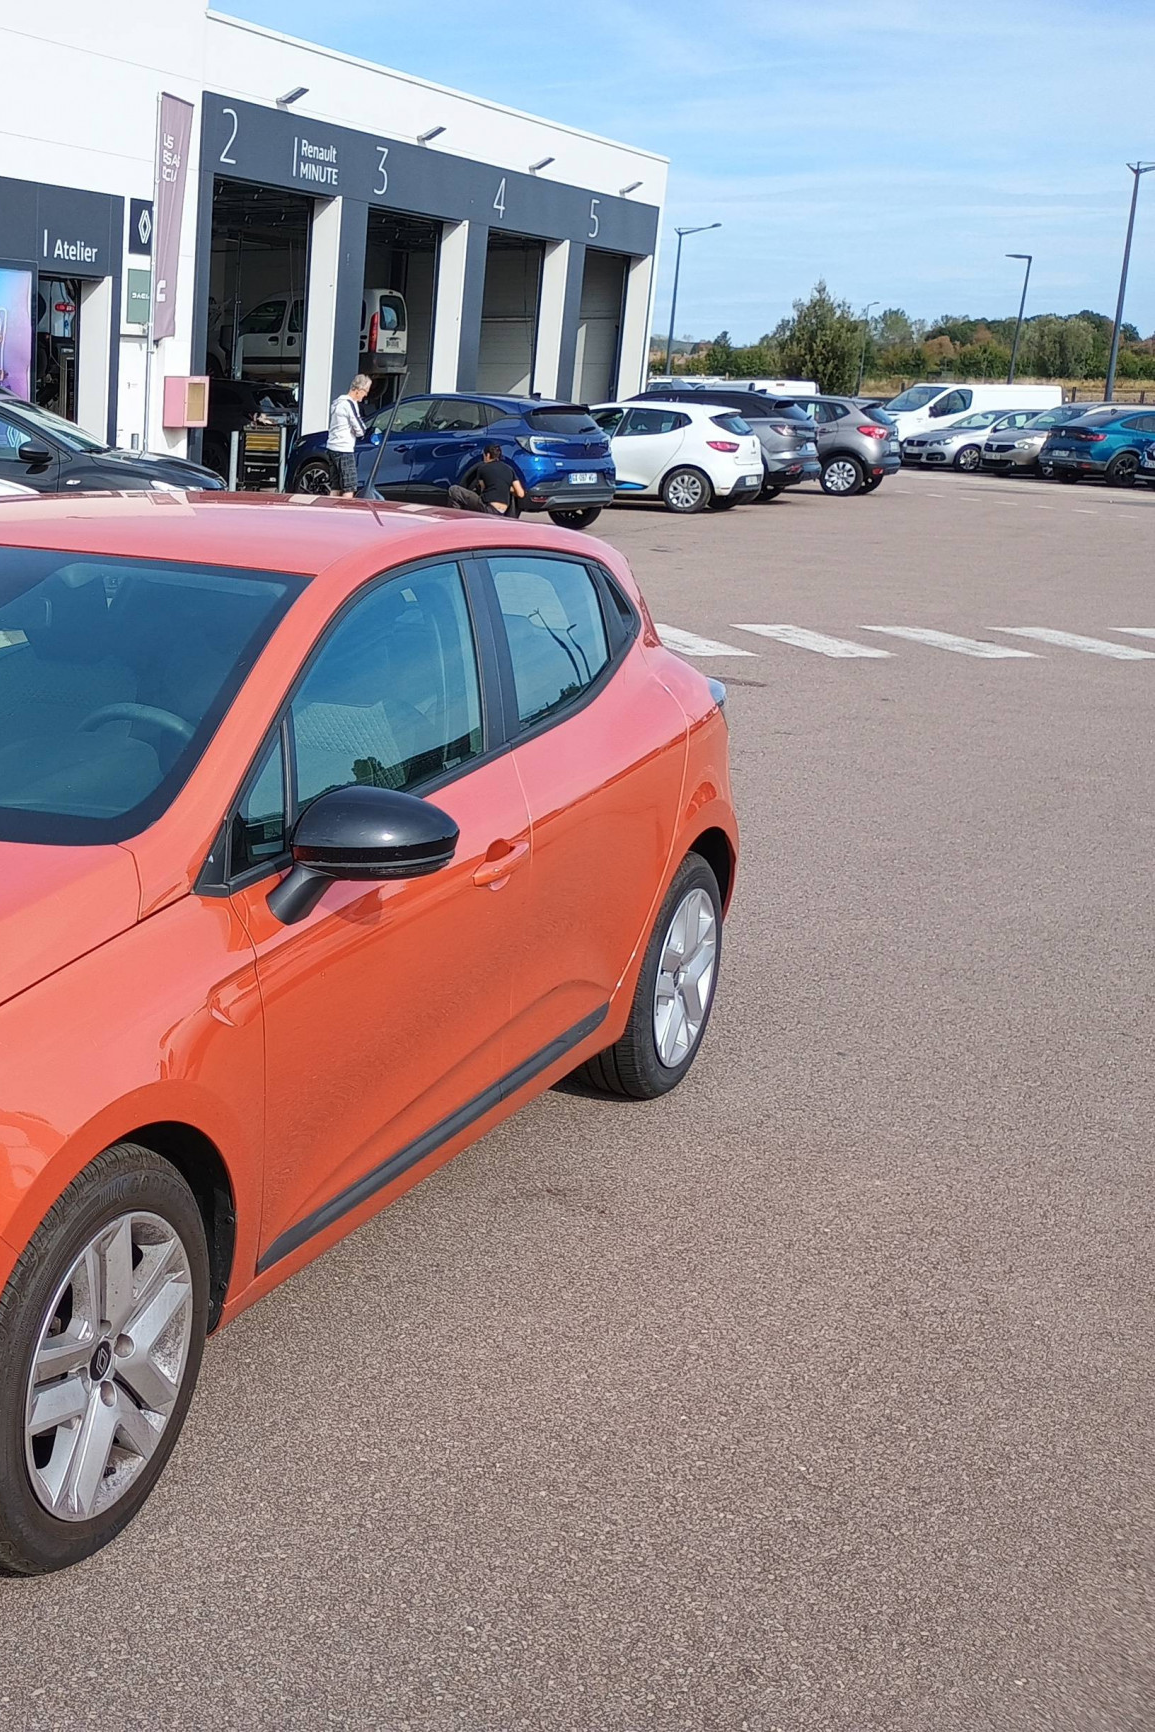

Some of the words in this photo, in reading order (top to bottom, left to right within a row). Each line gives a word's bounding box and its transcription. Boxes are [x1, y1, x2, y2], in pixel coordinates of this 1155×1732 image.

[219, 108, 239, 165] 2
[301, 139, 337, 163] Renault
[299, 162, 339, 185] MINUTE
[373, 146, 390, 195] 3
[493, 177, 506, 219] 4
[588, 199, 601, 238] 5
[53, 239, 98, 263] Atelier
